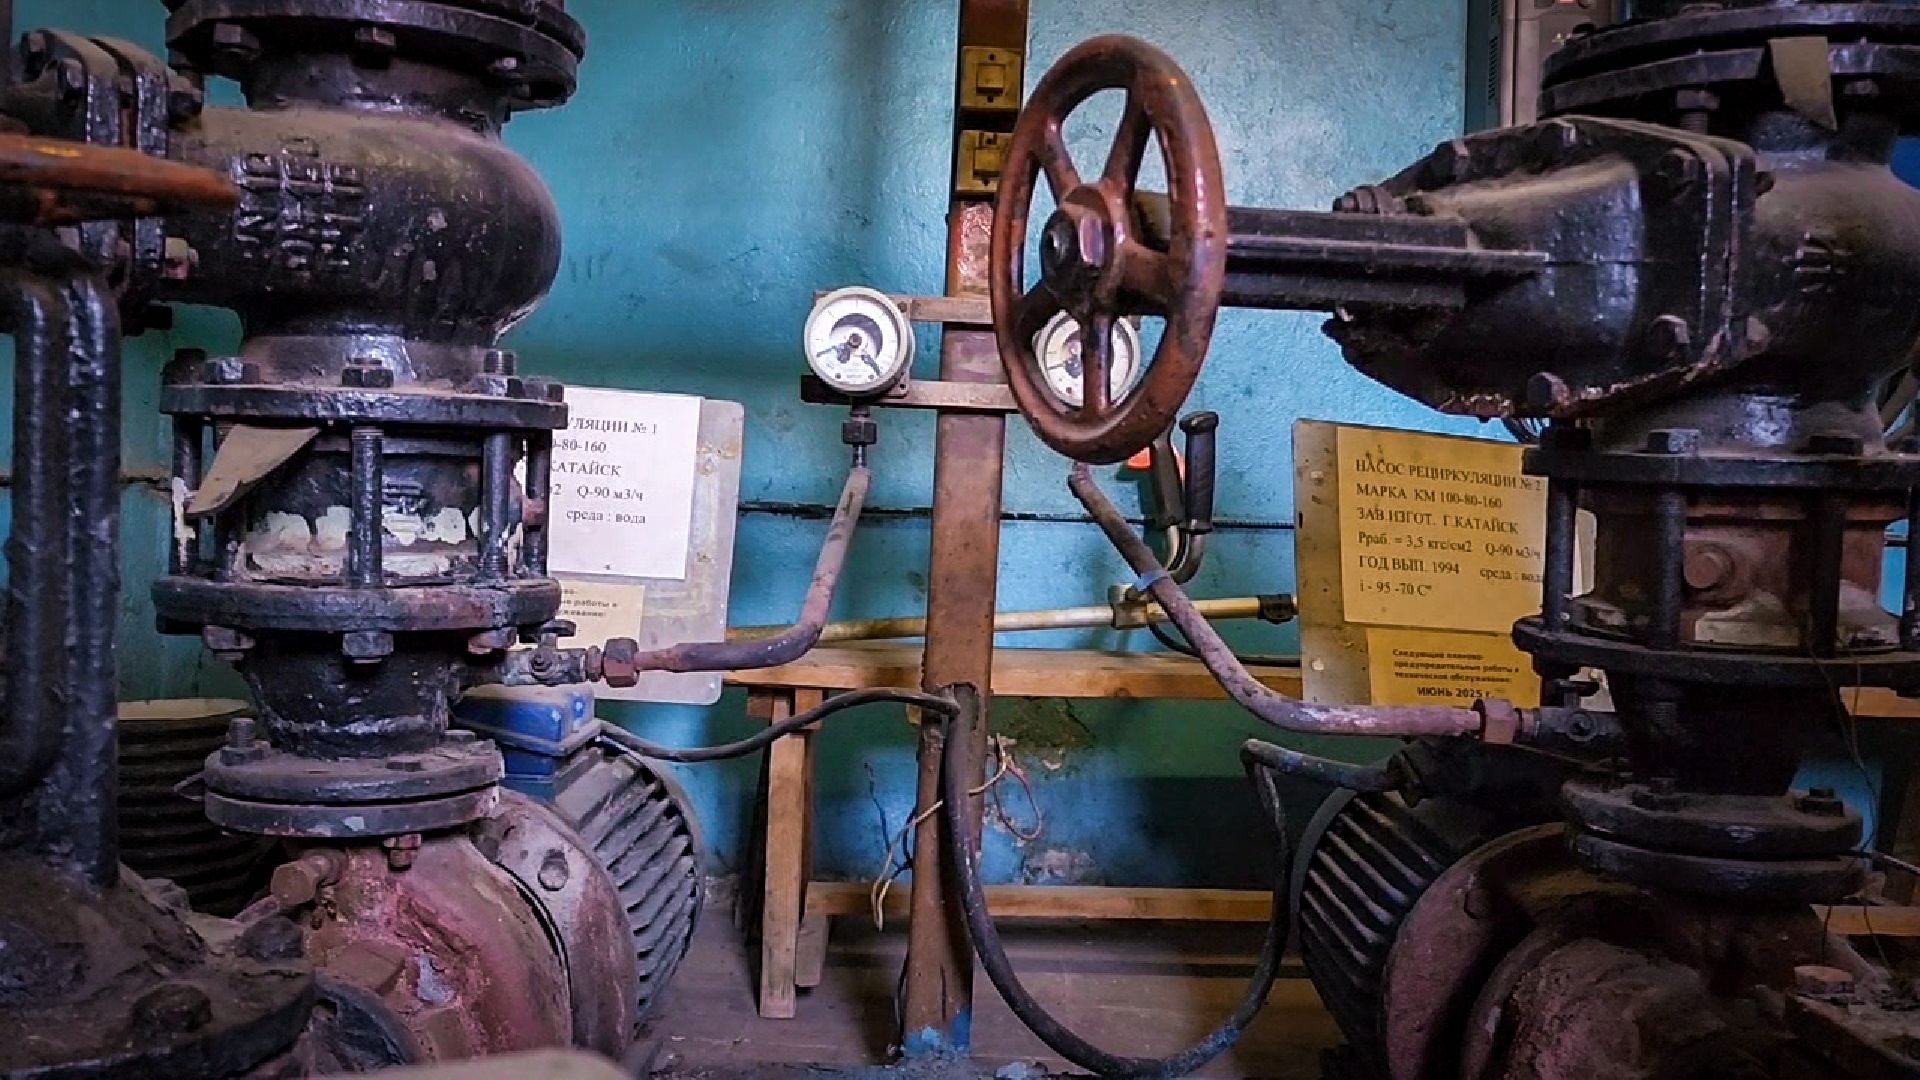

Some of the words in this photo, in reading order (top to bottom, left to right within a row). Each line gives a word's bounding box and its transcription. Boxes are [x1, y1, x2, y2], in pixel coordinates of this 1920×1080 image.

[631, 422, 648, 434] №
[652, 423, 658, 435] 1
[1356, 458, 1405, 475] НАСОС
[1409, 464, 1517, 489] РЕЦИРКУЛЯЦИИ
[1519, 477, 1533, 490] №
[1535, 480, 1541, 491] 2
[577, 485, 610, 499] Q-90
[613, 489, 644, 501] м3/ч
[1356, 483, 1407, 500] МАРКА
[1414, 488, 1436, 503] КМ
[1440, 491, 1503, 509] 100-80-160
[566, 511, 604, 523] среда
[615, 514, 646, 524] вода
[1406, 535, 1424, 549] 3,5
[1428, 540, 1472, 553] кгс/см2
[1485, 543, 1513, 557] Q-90
[1359, 555, 1390, 570] ГОД
[1432, 561, 1459, 574] 1994
[1480, 568, 1512, 580] среда
[1376, 581, 1391, 593] 95
[1416, 686, 1453, 697] ИЮНЬ
[1455, 687, 1483, 698] 2025
